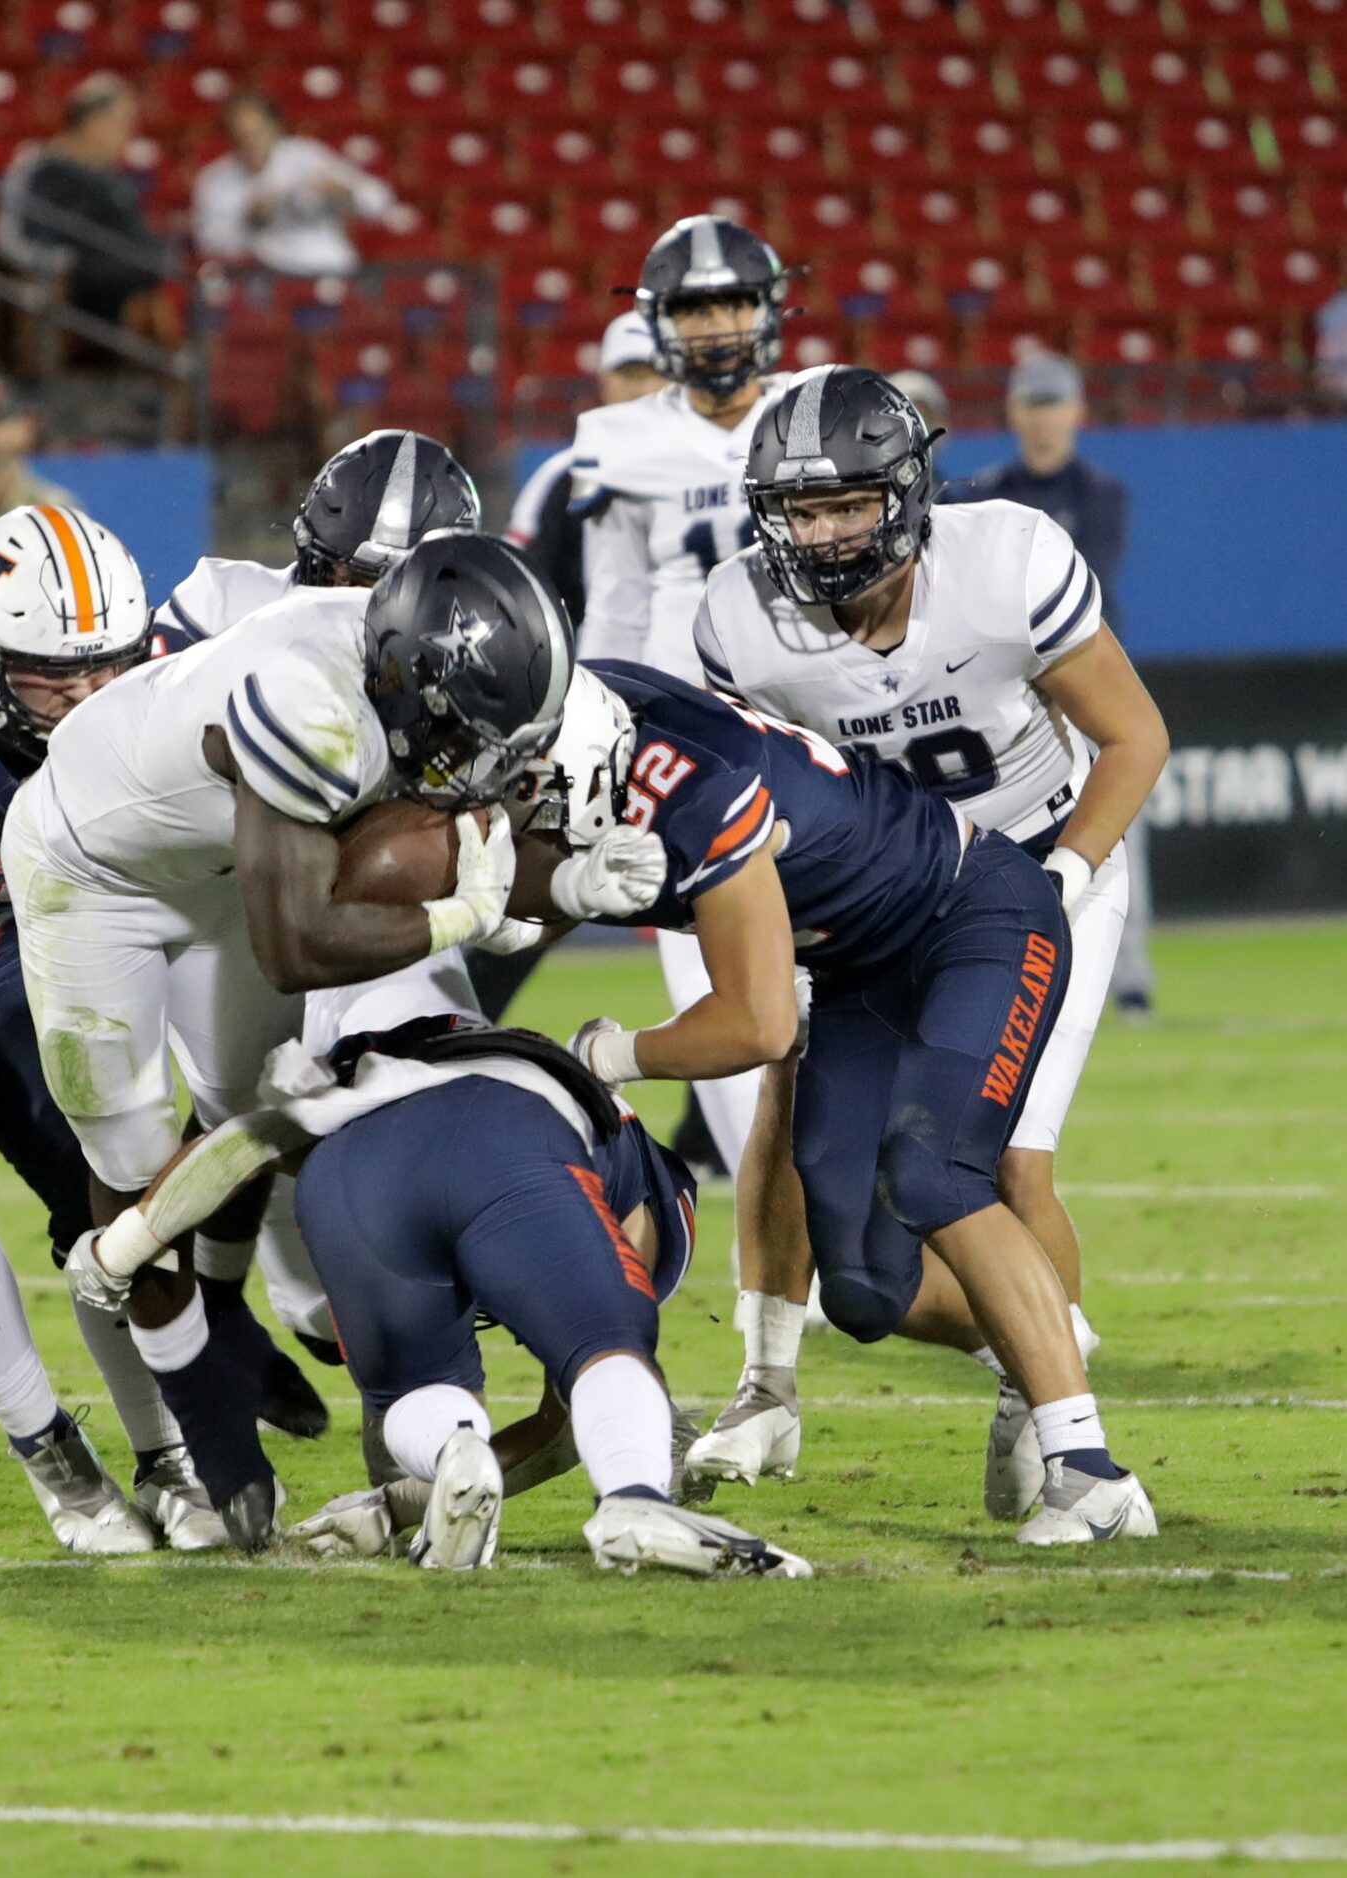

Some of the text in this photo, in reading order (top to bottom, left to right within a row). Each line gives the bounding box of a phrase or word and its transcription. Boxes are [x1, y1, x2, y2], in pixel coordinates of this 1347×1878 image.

[683, 482, 729, 512] LONE
[63, 641, 95, 655] TEAM
[837, 695, 962, 737] LONE STAR
[1150, 745, 1293, 827] STAR
[981, 931, 1057, 1108] WAKELAND
